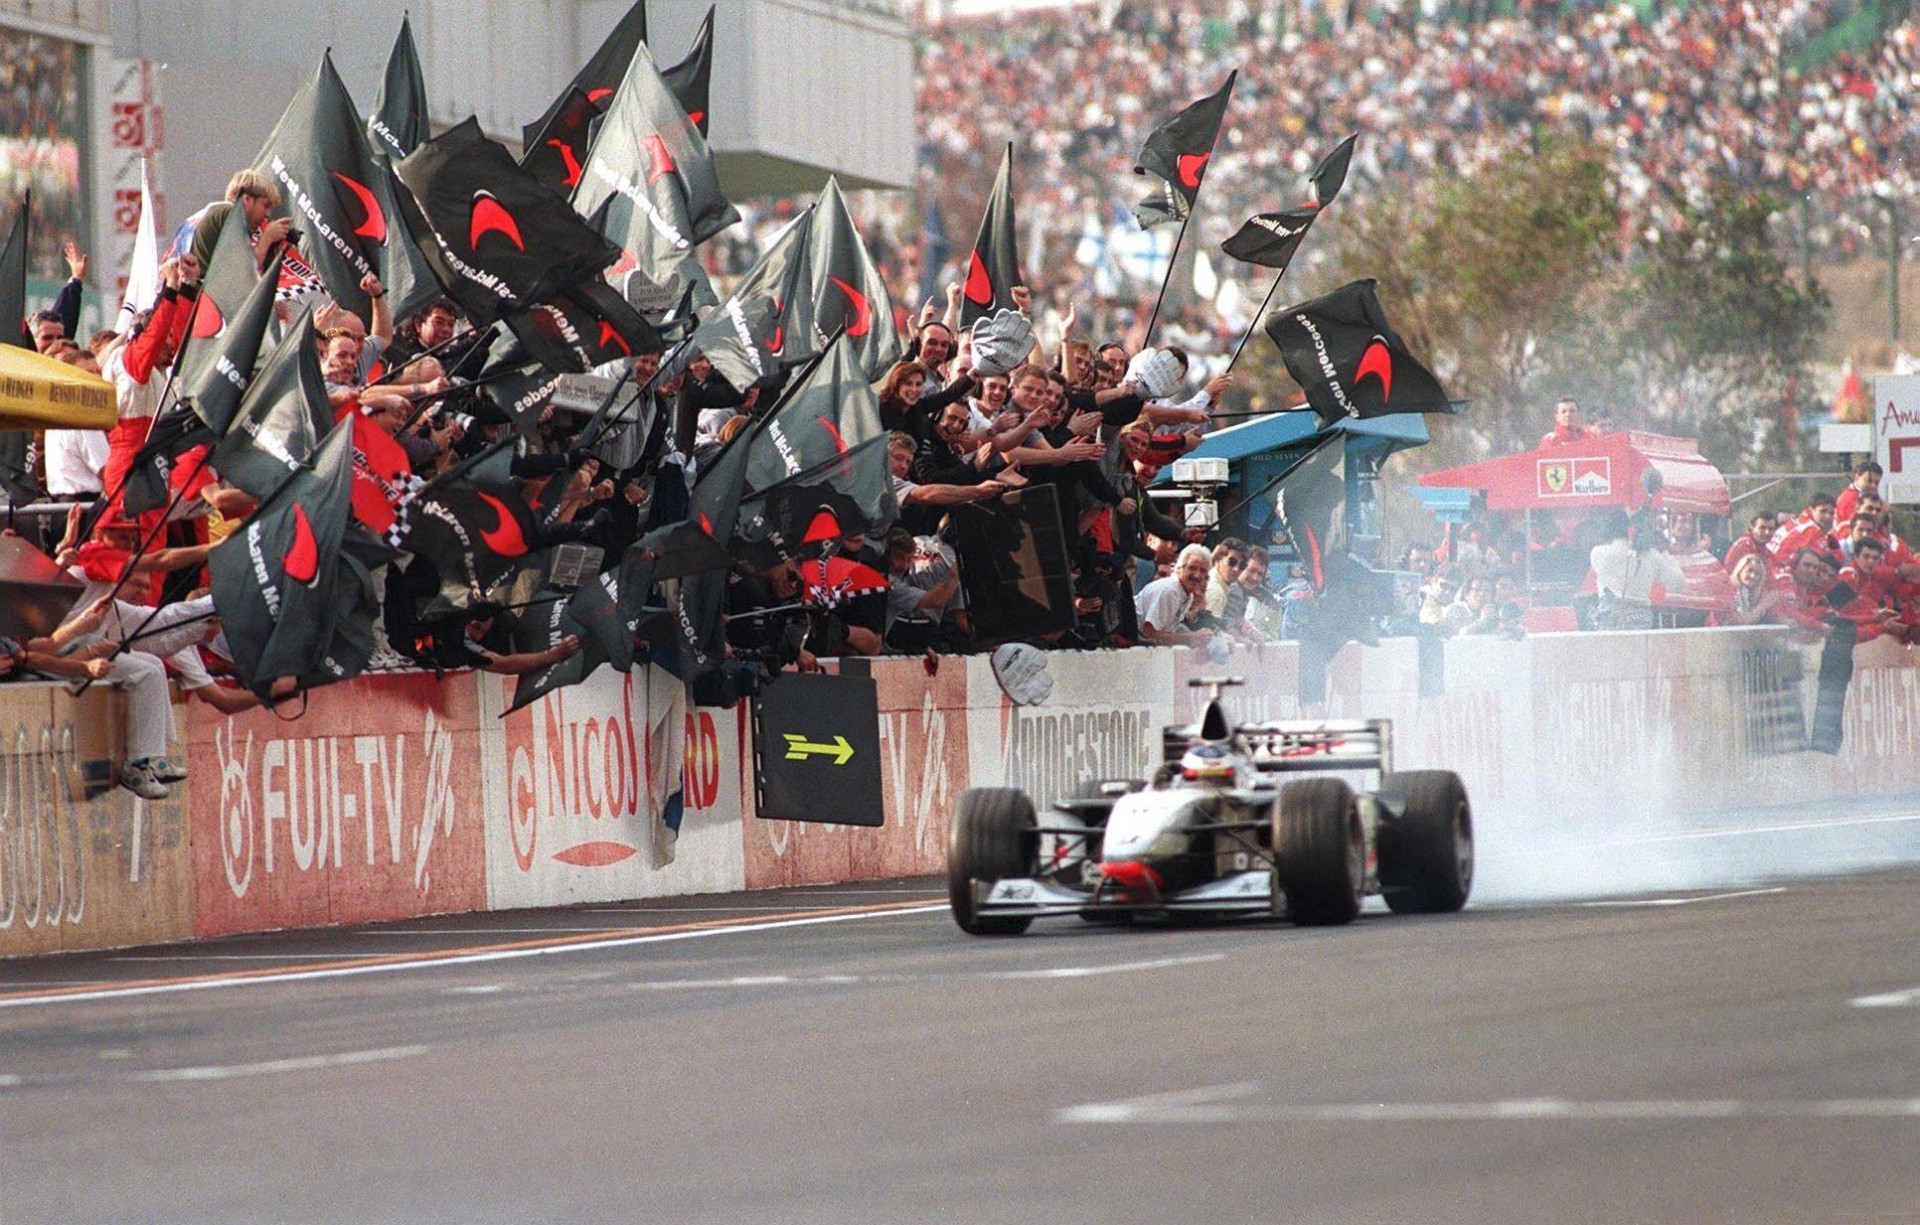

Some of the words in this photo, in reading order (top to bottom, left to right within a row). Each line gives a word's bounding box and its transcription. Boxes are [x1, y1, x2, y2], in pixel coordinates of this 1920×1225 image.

[271, 154, 299, 197] West
[298, 192, 354, 259] McLaren
[216, 354, 248, 391] Wes
[774, 432, 803, 477] McLare
[262, 734, 405, 872] FUJI-TV
[1003, 703, 1150, 814] BRIDGESTONE
